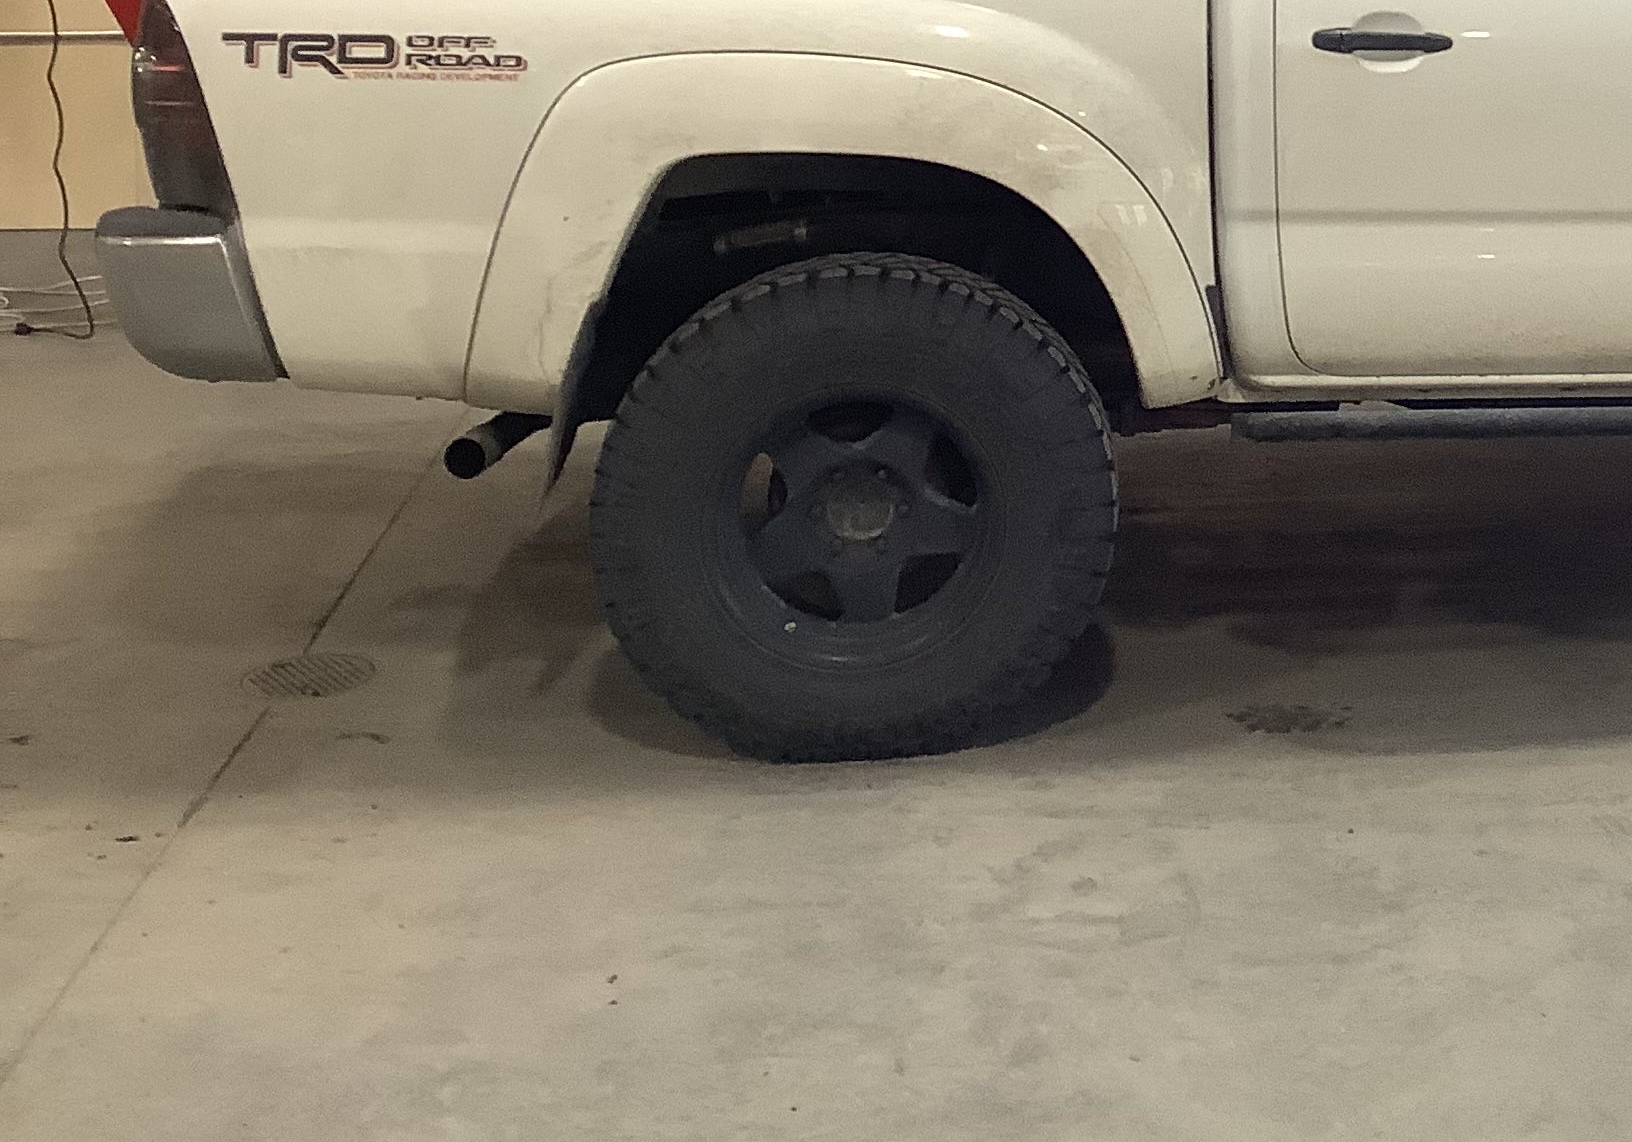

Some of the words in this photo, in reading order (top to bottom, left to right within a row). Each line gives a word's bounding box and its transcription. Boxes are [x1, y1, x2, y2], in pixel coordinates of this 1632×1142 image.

[405, 35, 495, 51] OFF
[222, 32, 398, 77] TRD
[405, 54, 527, 70] ROAD
